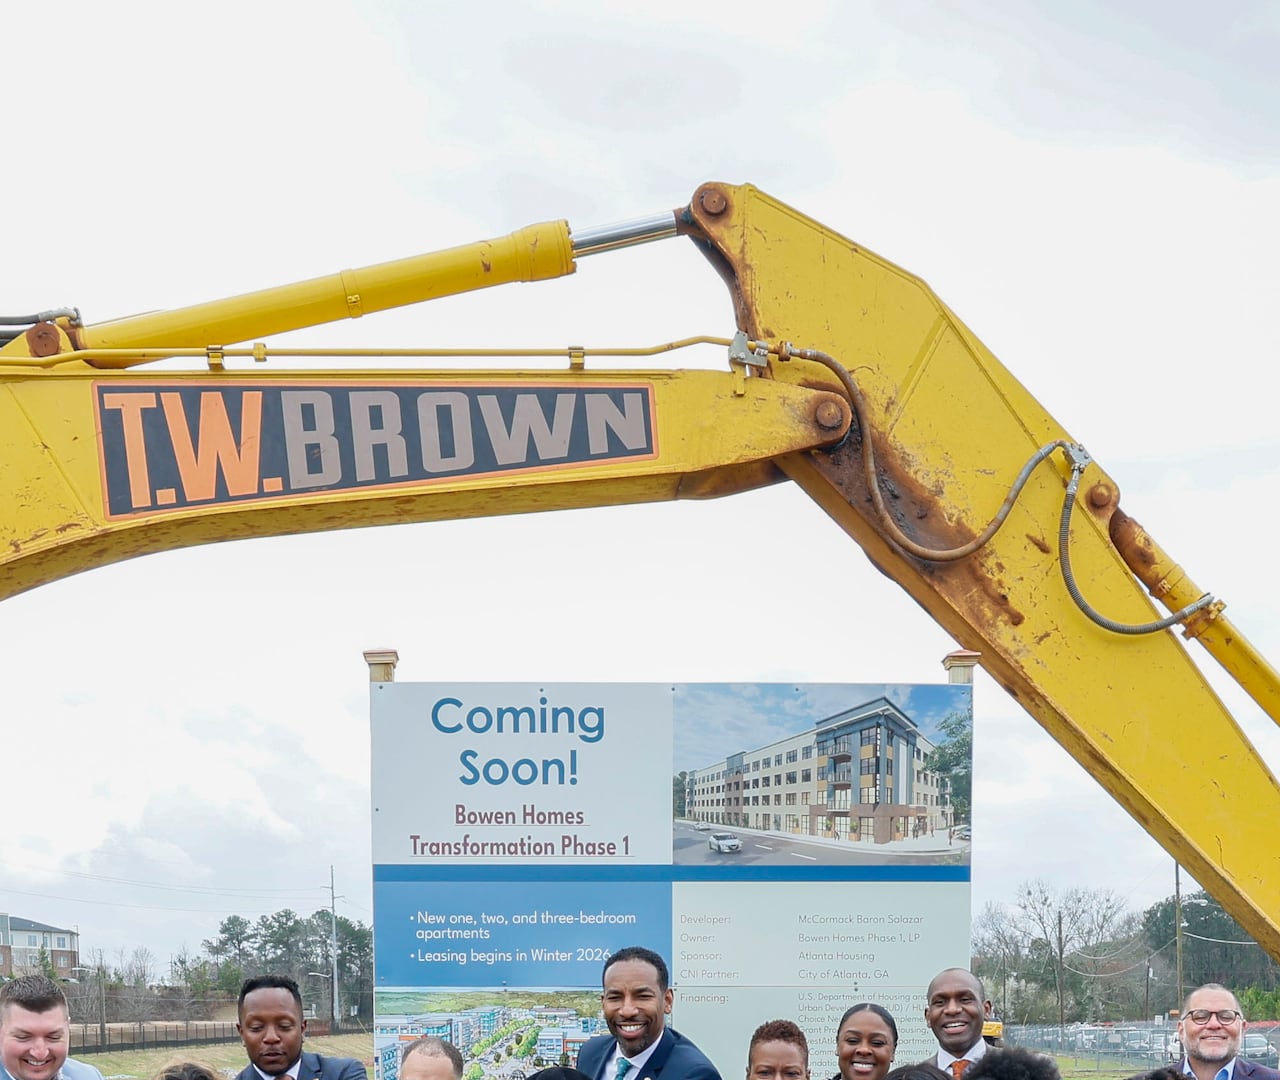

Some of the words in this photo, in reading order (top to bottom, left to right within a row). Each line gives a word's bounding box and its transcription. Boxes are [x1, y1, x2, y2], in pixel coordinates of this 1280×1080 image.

[431, 696, 605, 743] Coming
[459, 749, 578, 785] Soon!
[455, 804, 516, 825] Bowen
[522, 804, 584, 825] Homes
[409, 834, 555, 856] Transformation
[561, 835, 617, 856] Phase
[622, 835, 630, 855] 1
[417, 911, 446, 924] New
[451, 914, 477, 925] one,
[481, 912, 509, 925] two,
[512, 911, 537, 924] and
[541, 911, 636, 924] three-bedroom
[680, 914, 731, 926] Developer:
[798, 914, 854, 924] McCormack
[856, 914, 885, 924] Baron
[887, 914, 924, 924] Salazar
[416, 927, 490, 942] apartments
[680, 933, 715, 943] Owner:
[798, 933, 830, 943] Bowen
[832, 933, 865, 943] Homes
[868, 933, 897, 943] Phase
[899, 933, 906, 944] 1,
[908, 933, 920, 943] LP
[418, 949, 467, 965] Leasing
[471, 949, 513, 965] begins
[516, 949, 528, 961] in
[531, 949, 573, 961] Winter
[576, 949, 611, 961] 2026
[680, 951, 722, 963] Sponsor:
[798, 951, 834, 961] Atlanta
[836, 951, 875, 963] Housing
[680, 970, 698, 979] CNI
[701, 970, 740, 979] Partner:
[798, 969, 817, 981] City
[820, 969, 831, 979] of
[832, 969, 871, 981] Atlanta,
[873, 969, 889, 979] GA
[680, 993, 729, 1004] Financing:
[798, 993, 816, 1001] U.S.
[818, 993, 865, 1003] Department
[867, 993, 877, 1001] of
[878, 993, 911, 1003] Housing
[798, 1004, 823, 1012] Urban
